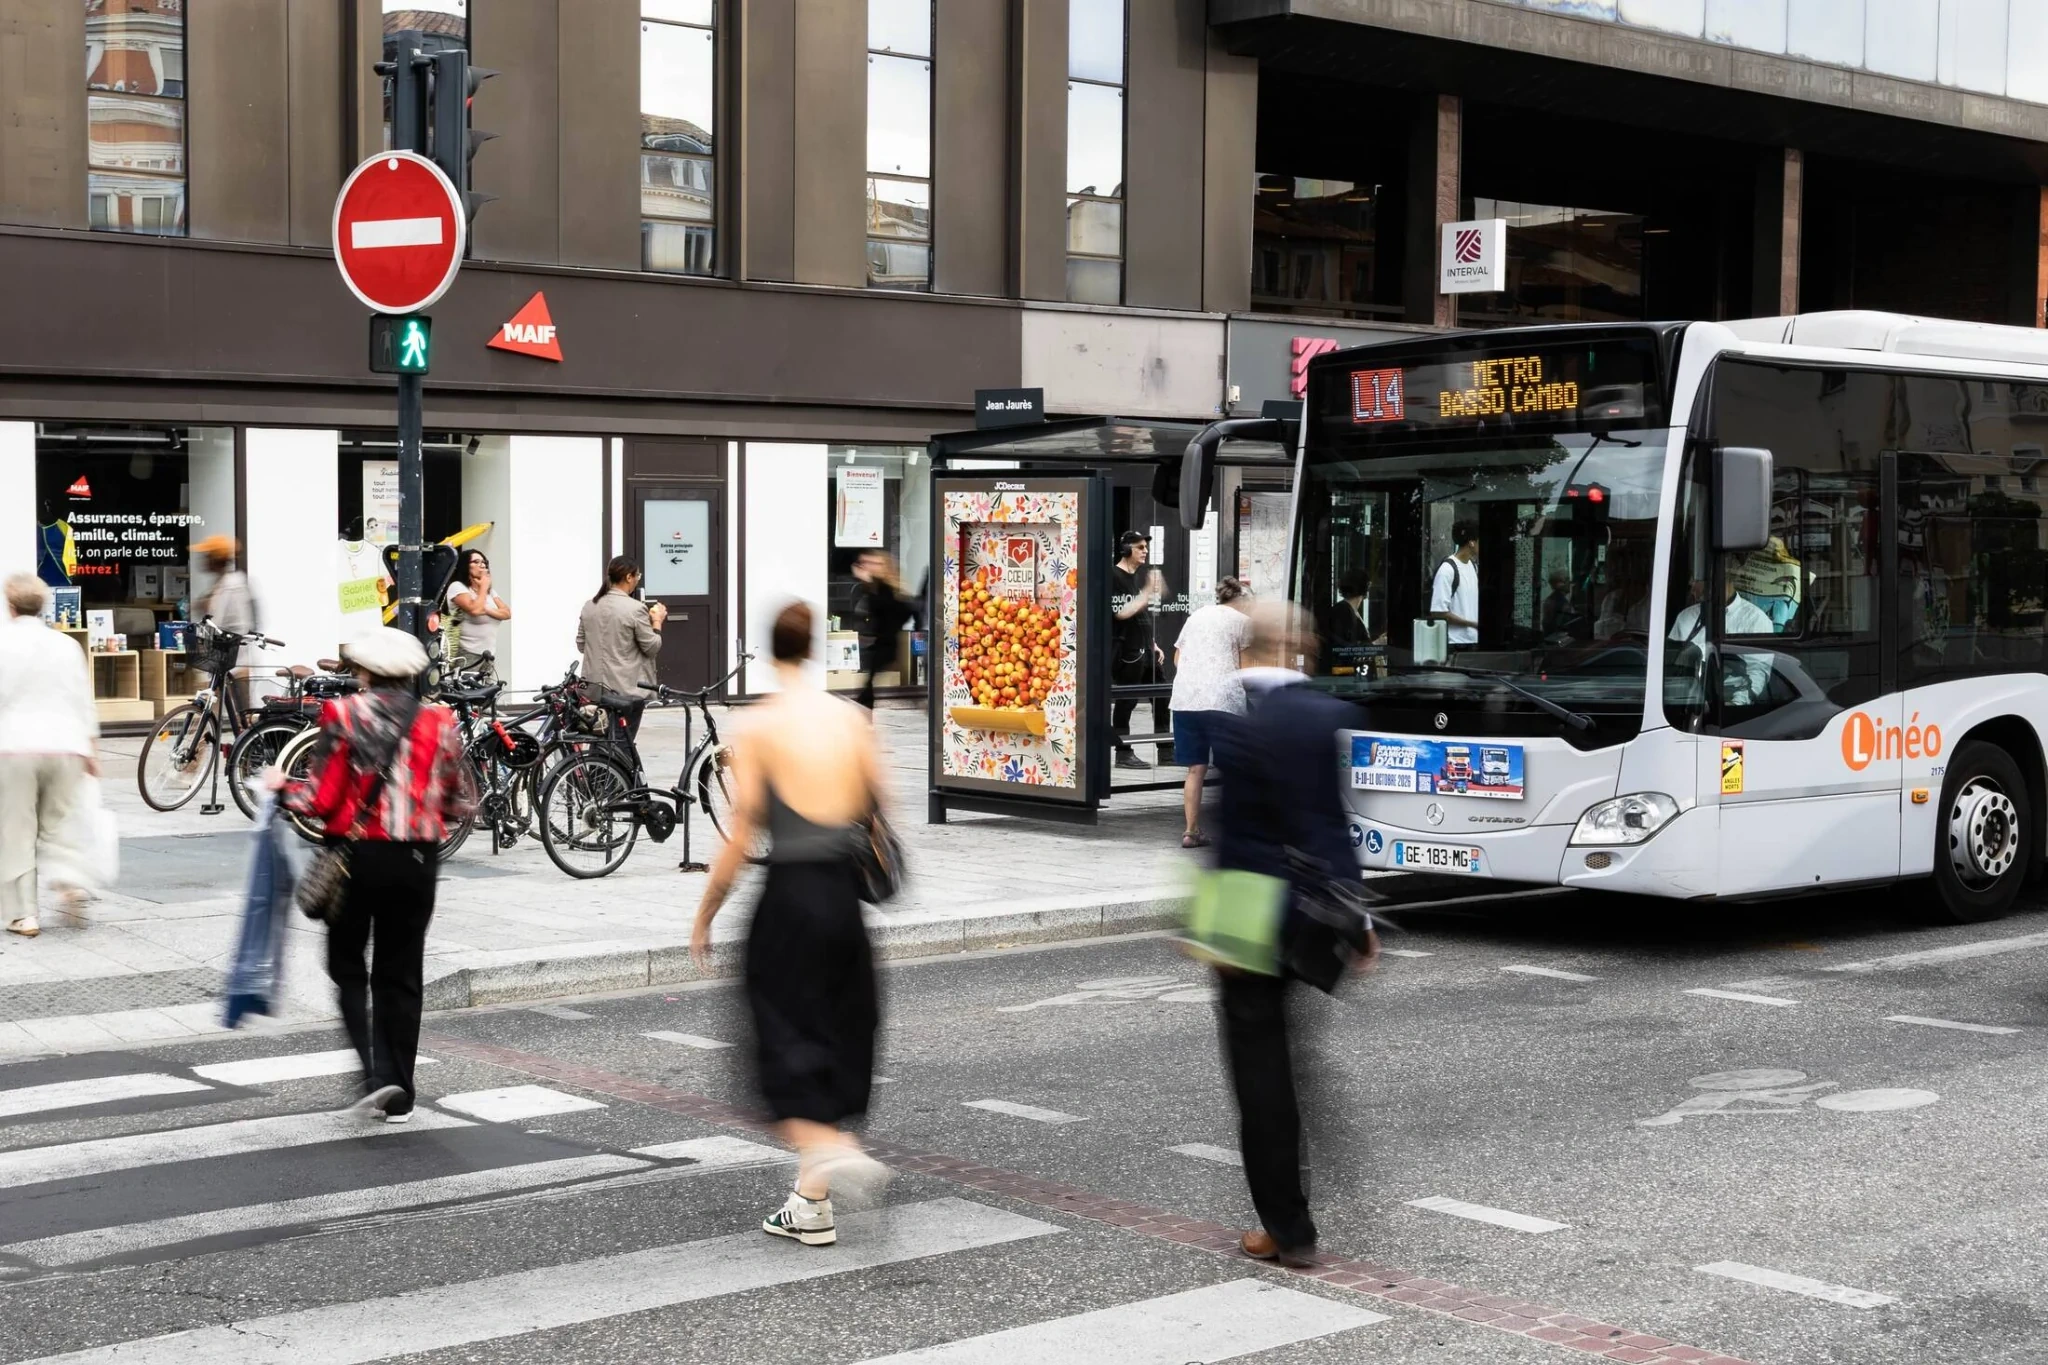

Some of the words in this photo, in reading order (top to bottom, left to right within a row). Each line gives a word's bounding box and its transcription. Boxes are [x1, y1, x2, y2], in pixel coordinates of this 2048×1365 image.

[1447, 266, 1488, 277] INTERVAL
[503, 322, 556, 345] MAIF
[1473, 355, 1542, 387] METRO
[1353, 372, 1401, 418] L14
[1440, 387, 1505, 417] BASSO
[1512, 381, 1578, 412] CAMBO
[986, 400, 1004, 410] Jean
[1005, 399, 1033, 410] Jaurès
[70, 484, 90, 492] MAIF
[994, 482, 1025, 490] JCDecaux
[67, 511, 147, 526] Assurances,
[149, 511, 206, 526] épargne,
[86, 548, 101, 557] on
[103, 546, 132, 559] parle
[135, 546, 149, 557] de
[152, 546, 178, 557] tout.
[69, 563, 112, 574] Entrez
[1850, 711, 1942, 766] Linéo
[1373, 757, 1416, 768] D'ALBI
